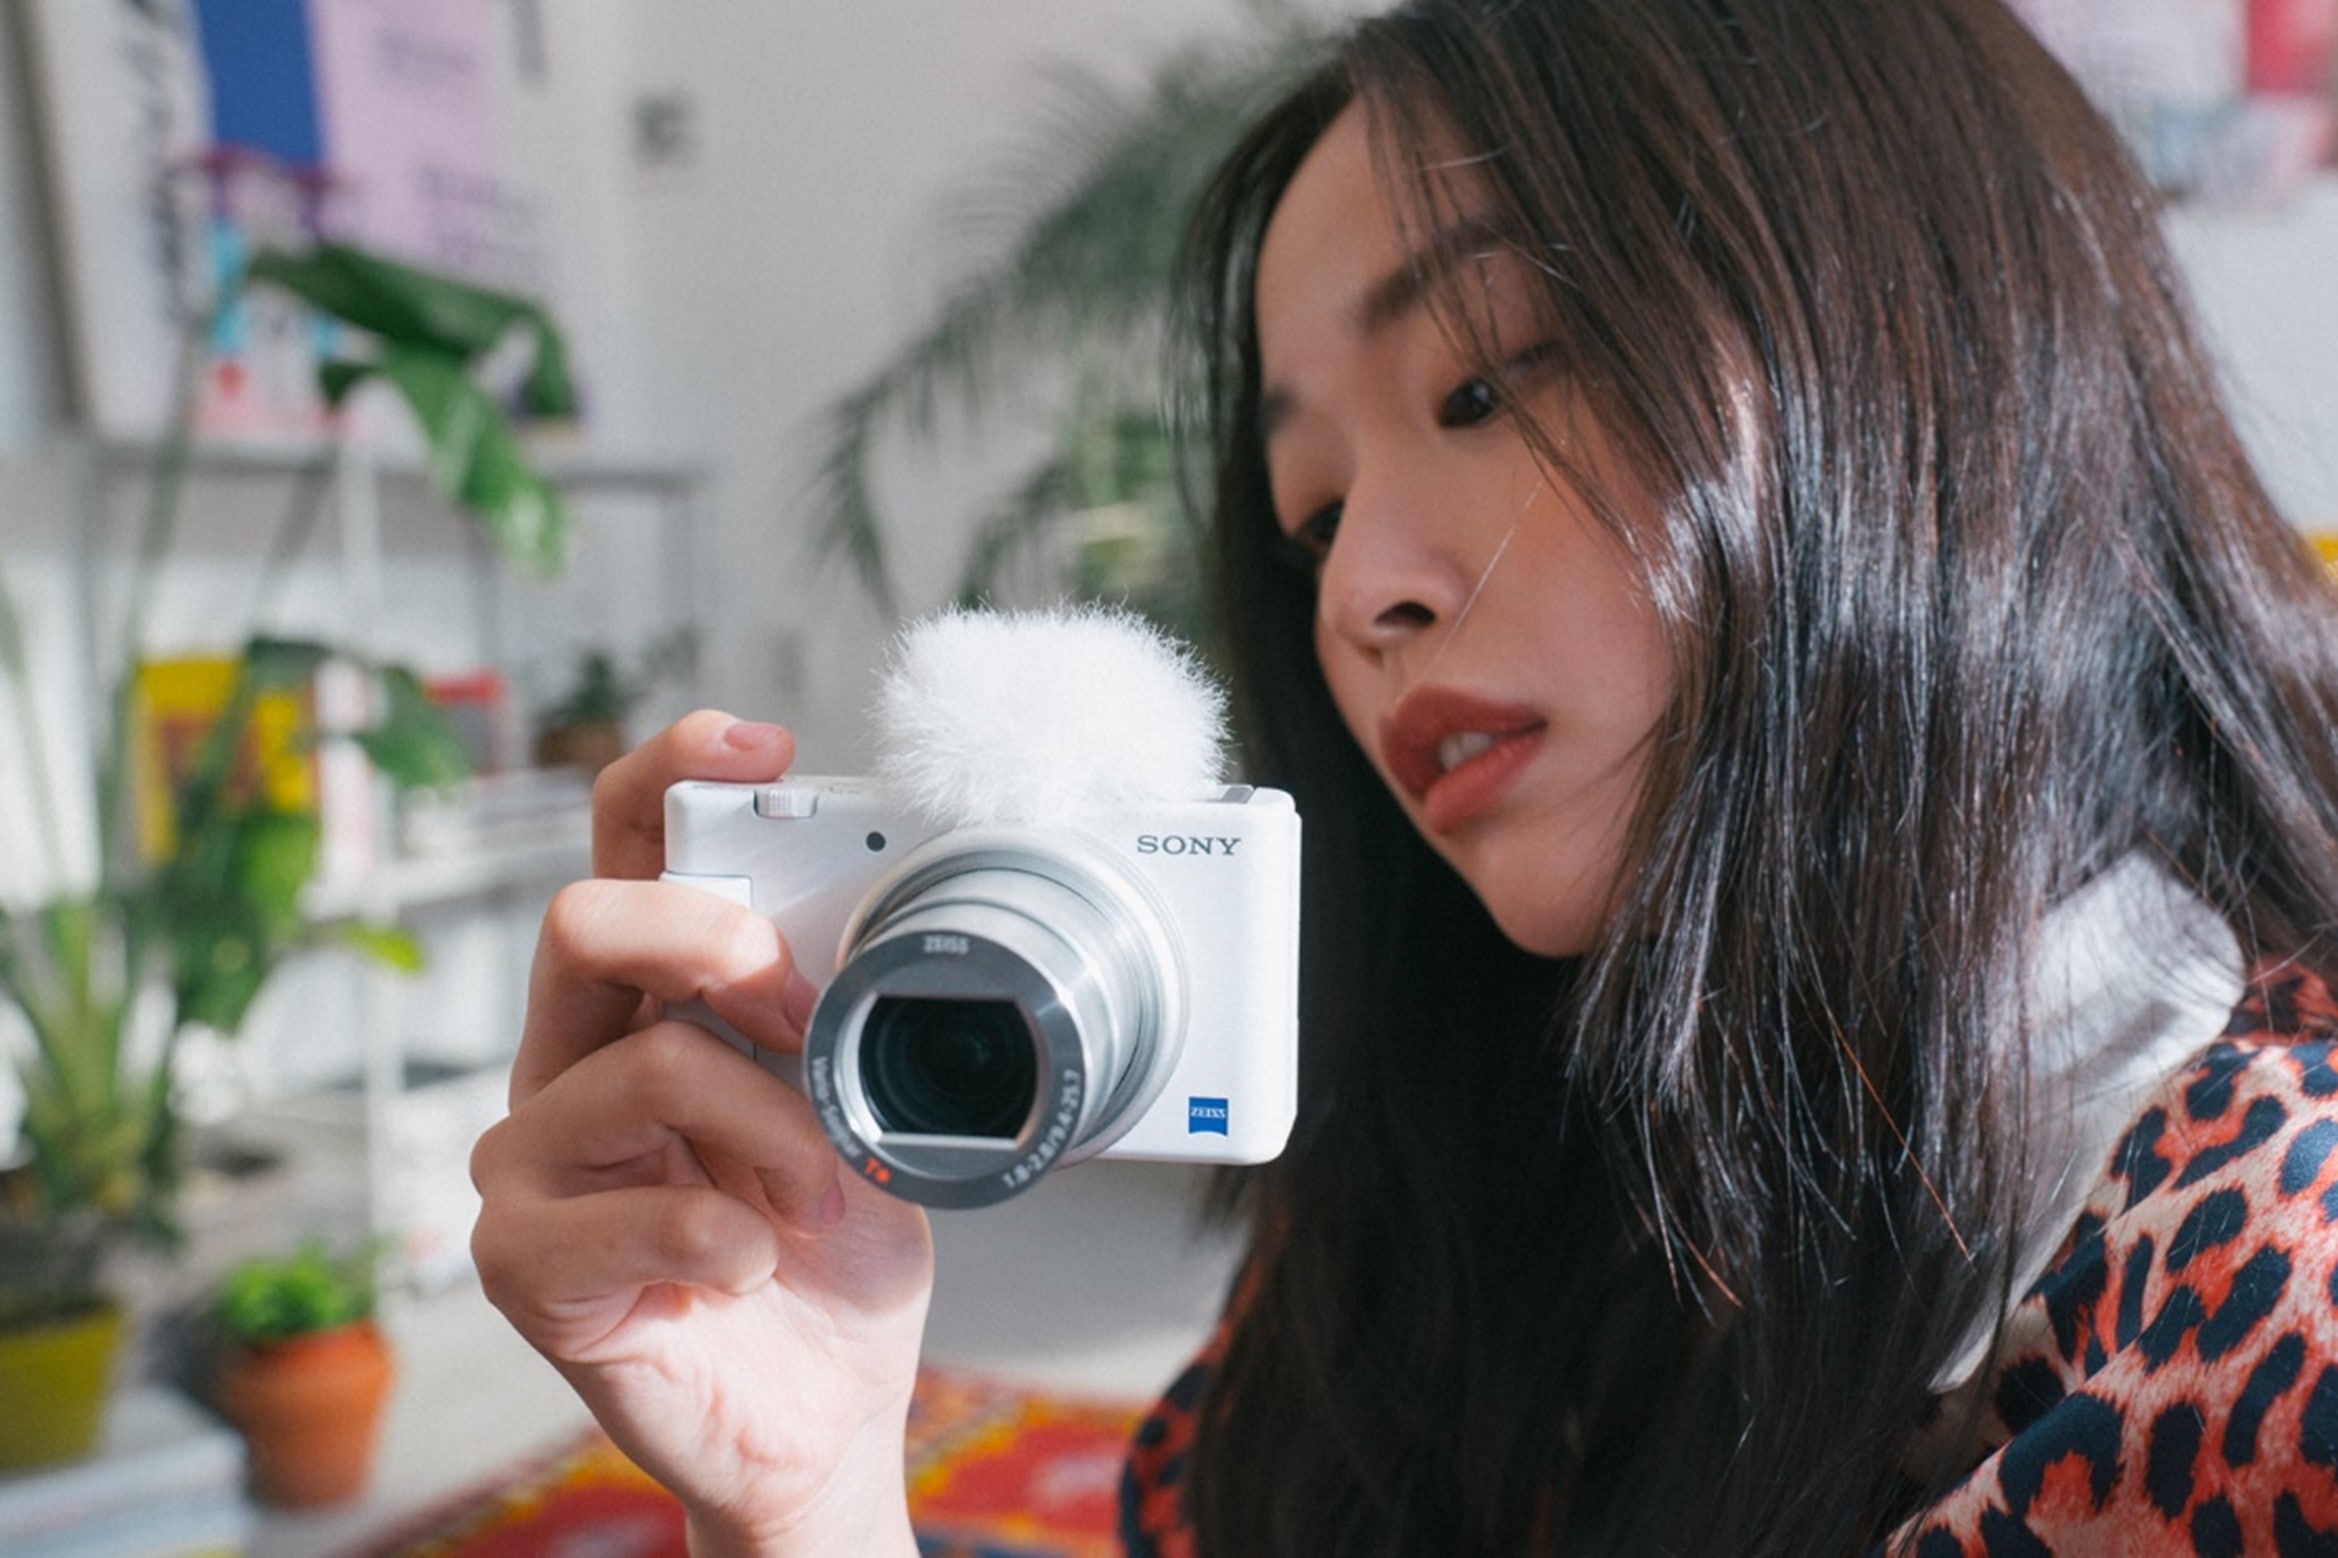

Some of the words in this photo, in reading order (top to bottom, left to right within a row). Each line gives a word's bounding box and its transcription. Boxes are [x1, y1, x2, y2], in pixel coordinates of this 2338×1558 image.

[1137, 834, 1241, 856] SONY
[924, 934, 970, 955] ZEISS
[1191, 1106, 1226, 1119] ZEISS
